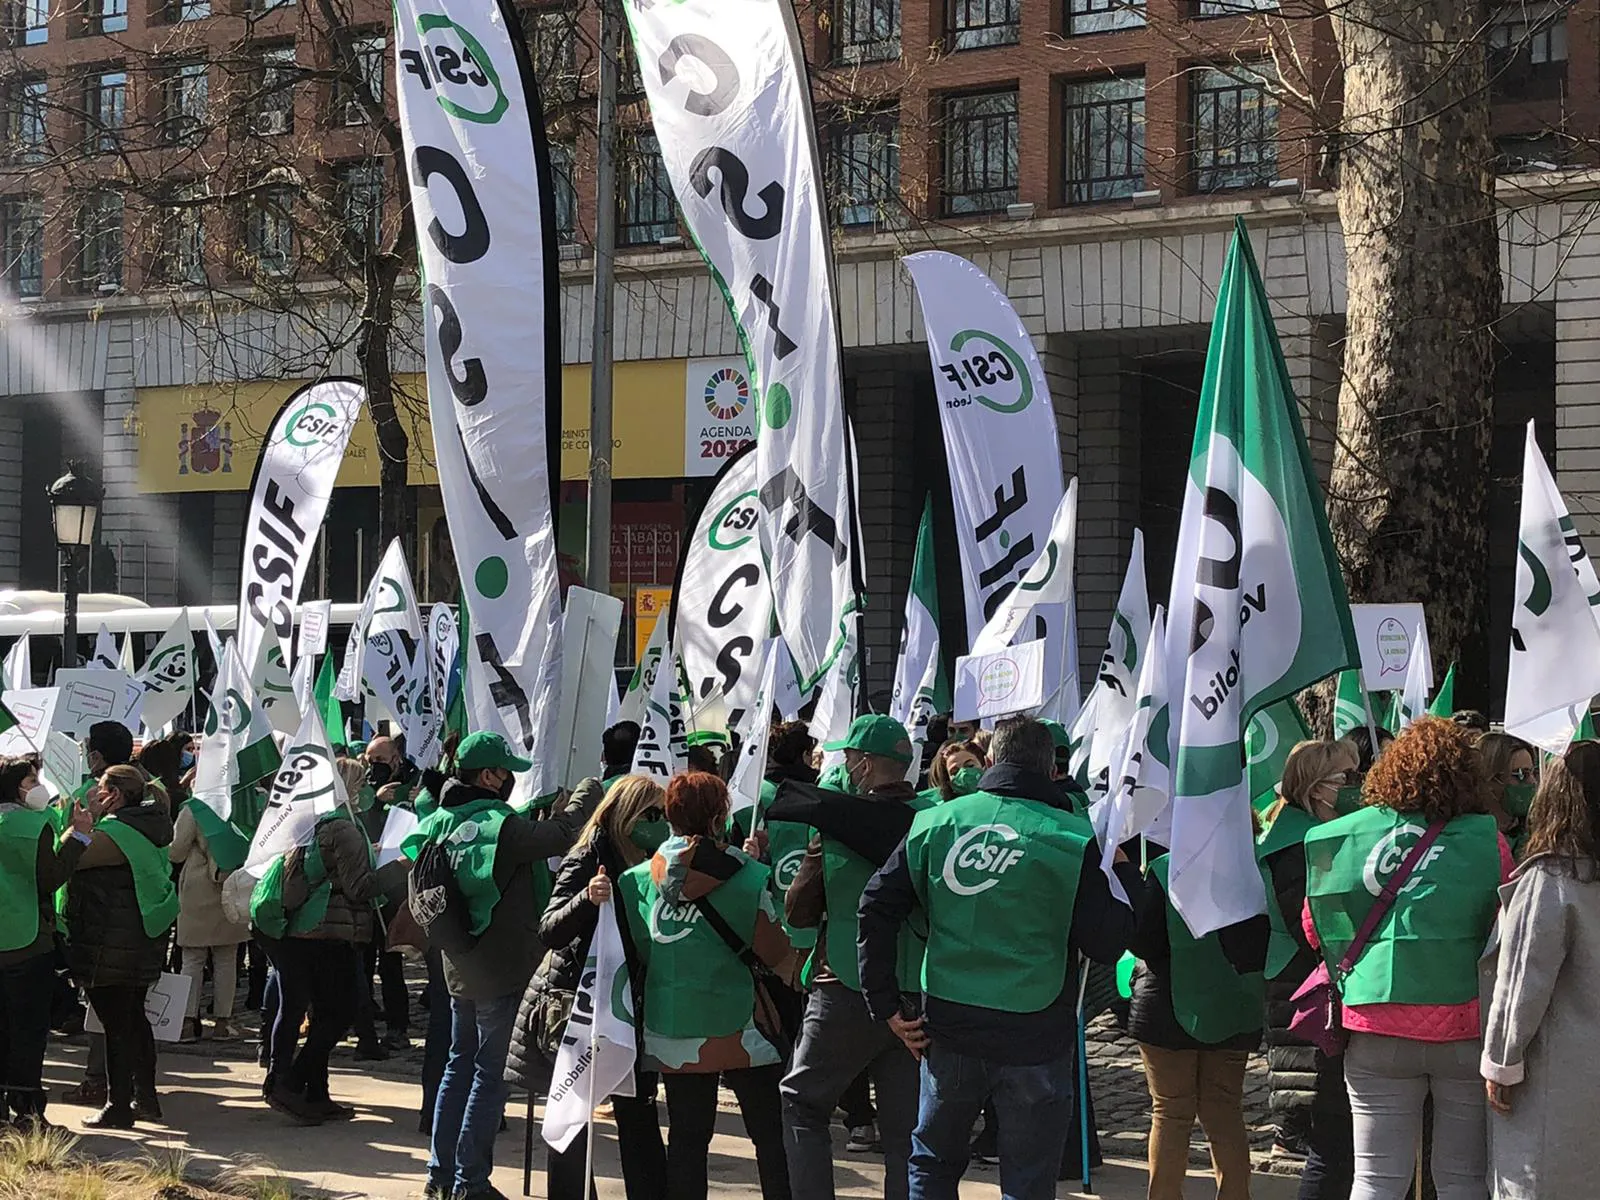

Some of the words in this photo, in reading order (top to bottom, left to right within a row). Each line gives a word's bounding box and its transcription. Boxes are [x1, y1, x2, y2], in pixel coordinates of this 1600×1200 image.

[297, 414, 338, 438] CSIF
[562, 428, 590, 439] MINIST
[700, 425, 752, 438] AGENDA
[562, 441, 573, 450] DE
[723, 506, 759, 530] CSI
[622, 531, 673, 544] TABACO
[247, 477, 306, 639] CSIF
[782, 859, 802, 878] CS
[957, 845, 1025, 875] CSIF
